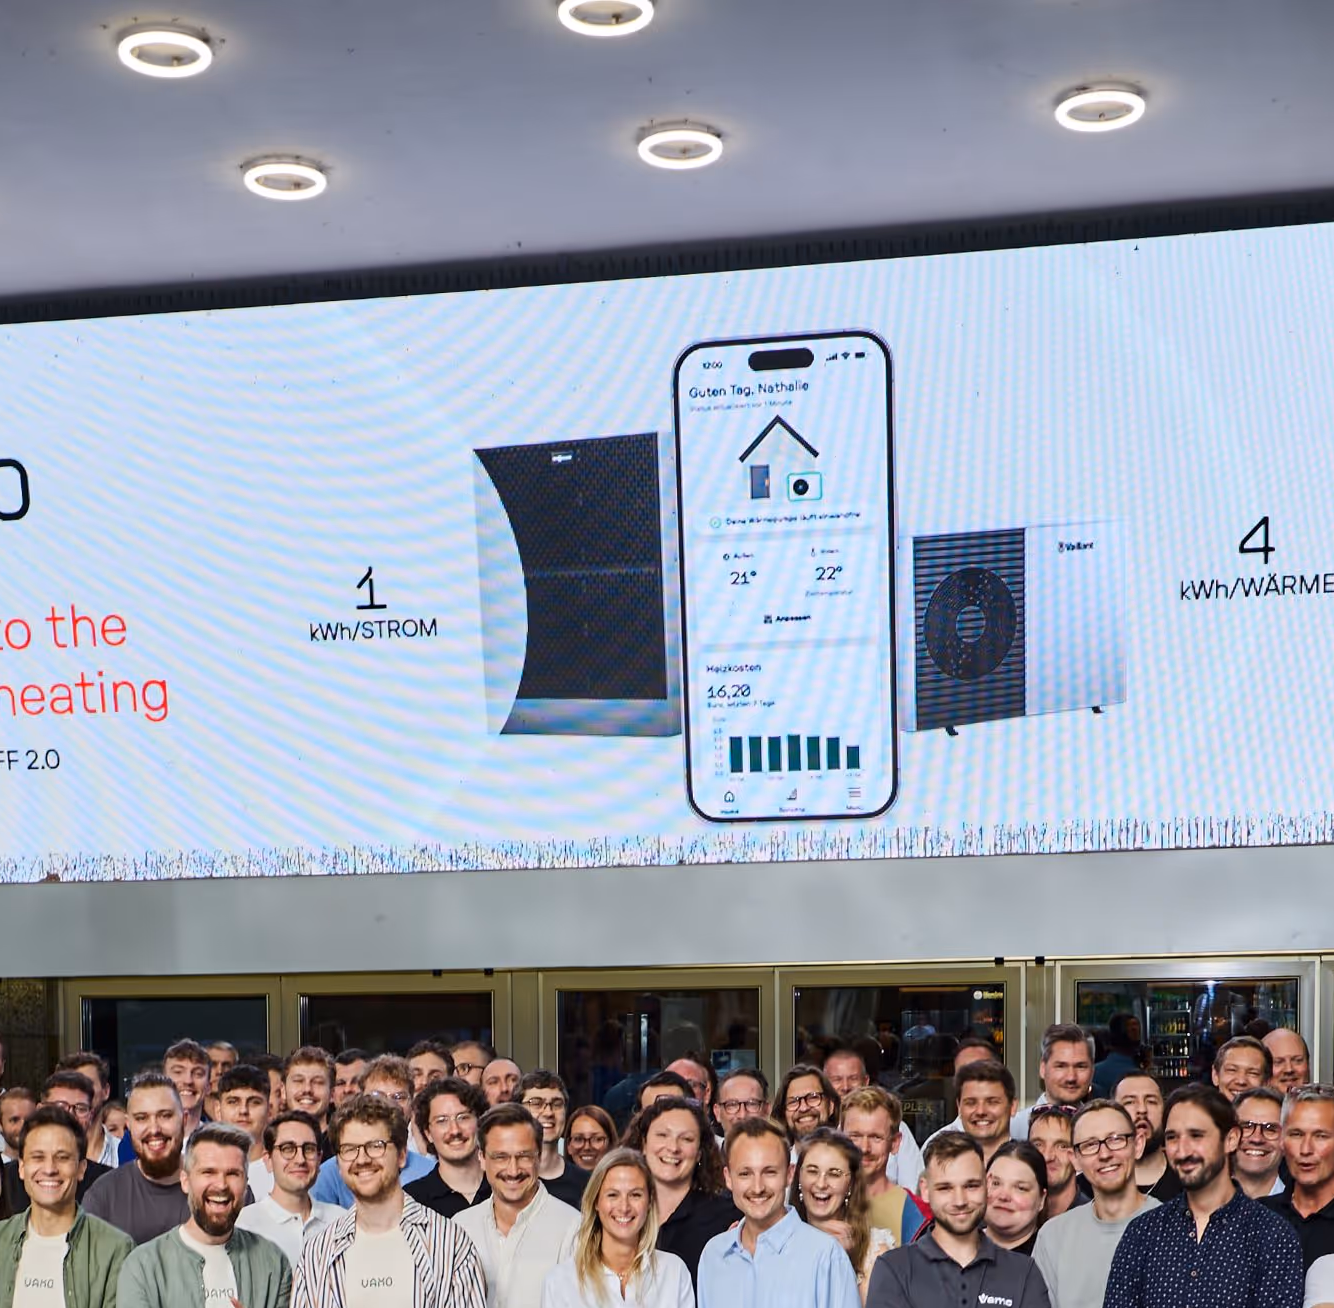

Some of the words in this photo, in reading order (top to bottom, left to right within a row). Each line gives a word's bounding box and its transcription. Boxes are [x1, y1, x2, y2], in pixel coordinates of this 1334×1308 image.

[1238, 516, 1276, 565] 4
[355, 566, 387, 610] 1
[45, 604, 128, 647] the
[309, 617, 438, 642] kWh/STROM
[26, 748, 61, 770] 2.0
[361, 1276, 394, 1289] VAMO
